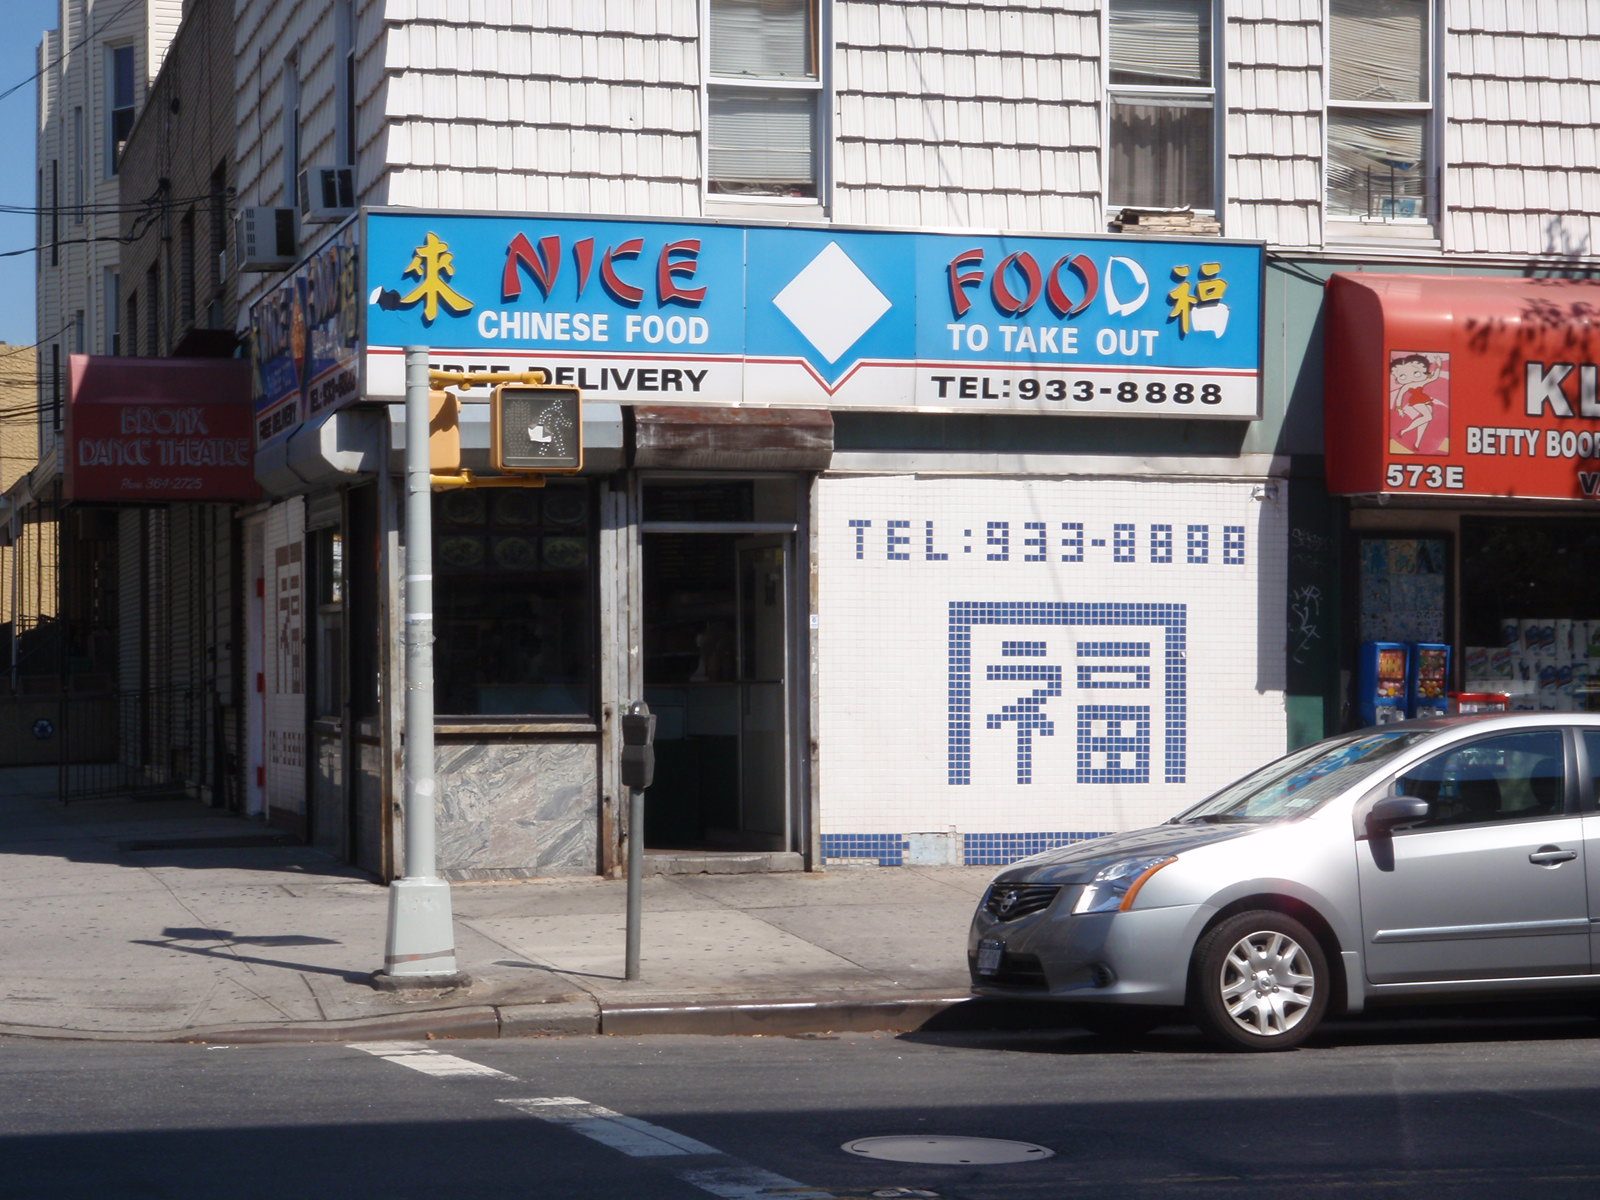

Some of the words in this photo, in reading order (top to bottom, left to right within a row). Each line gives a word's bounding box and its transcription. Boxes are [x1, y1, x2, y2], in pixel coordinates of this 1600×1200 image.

[503, 231, 708, 303] NICE
[948, 248, 1150, 318] FOOD
[1168, 261, 1231, 340] 福
[477, 310, 609, 343] CHINESE
[625, 314, 710, 346] FOOD
[946, 323, 989, 352] TO
[998, 325, 1079, 355] TAKE
[1096, 328, 1159, 357] OUT
[428, 363, 511, 388] EE
[931, 375, 1223, 406] TEL:933-8888
[120, 407, 209, 435] BRONX
[78, 438, 152, 467] DANCE
[156, 438, 250, 467] THEATRE
[1466, 425, 1540, 457] BETTY
[1385, 463, 1466, 490] 573E
[1578, 471, 1600, 496] V
[849, 519, 1246, 565] TEL:933-8888
[985, 640, 1152, 785] 福
